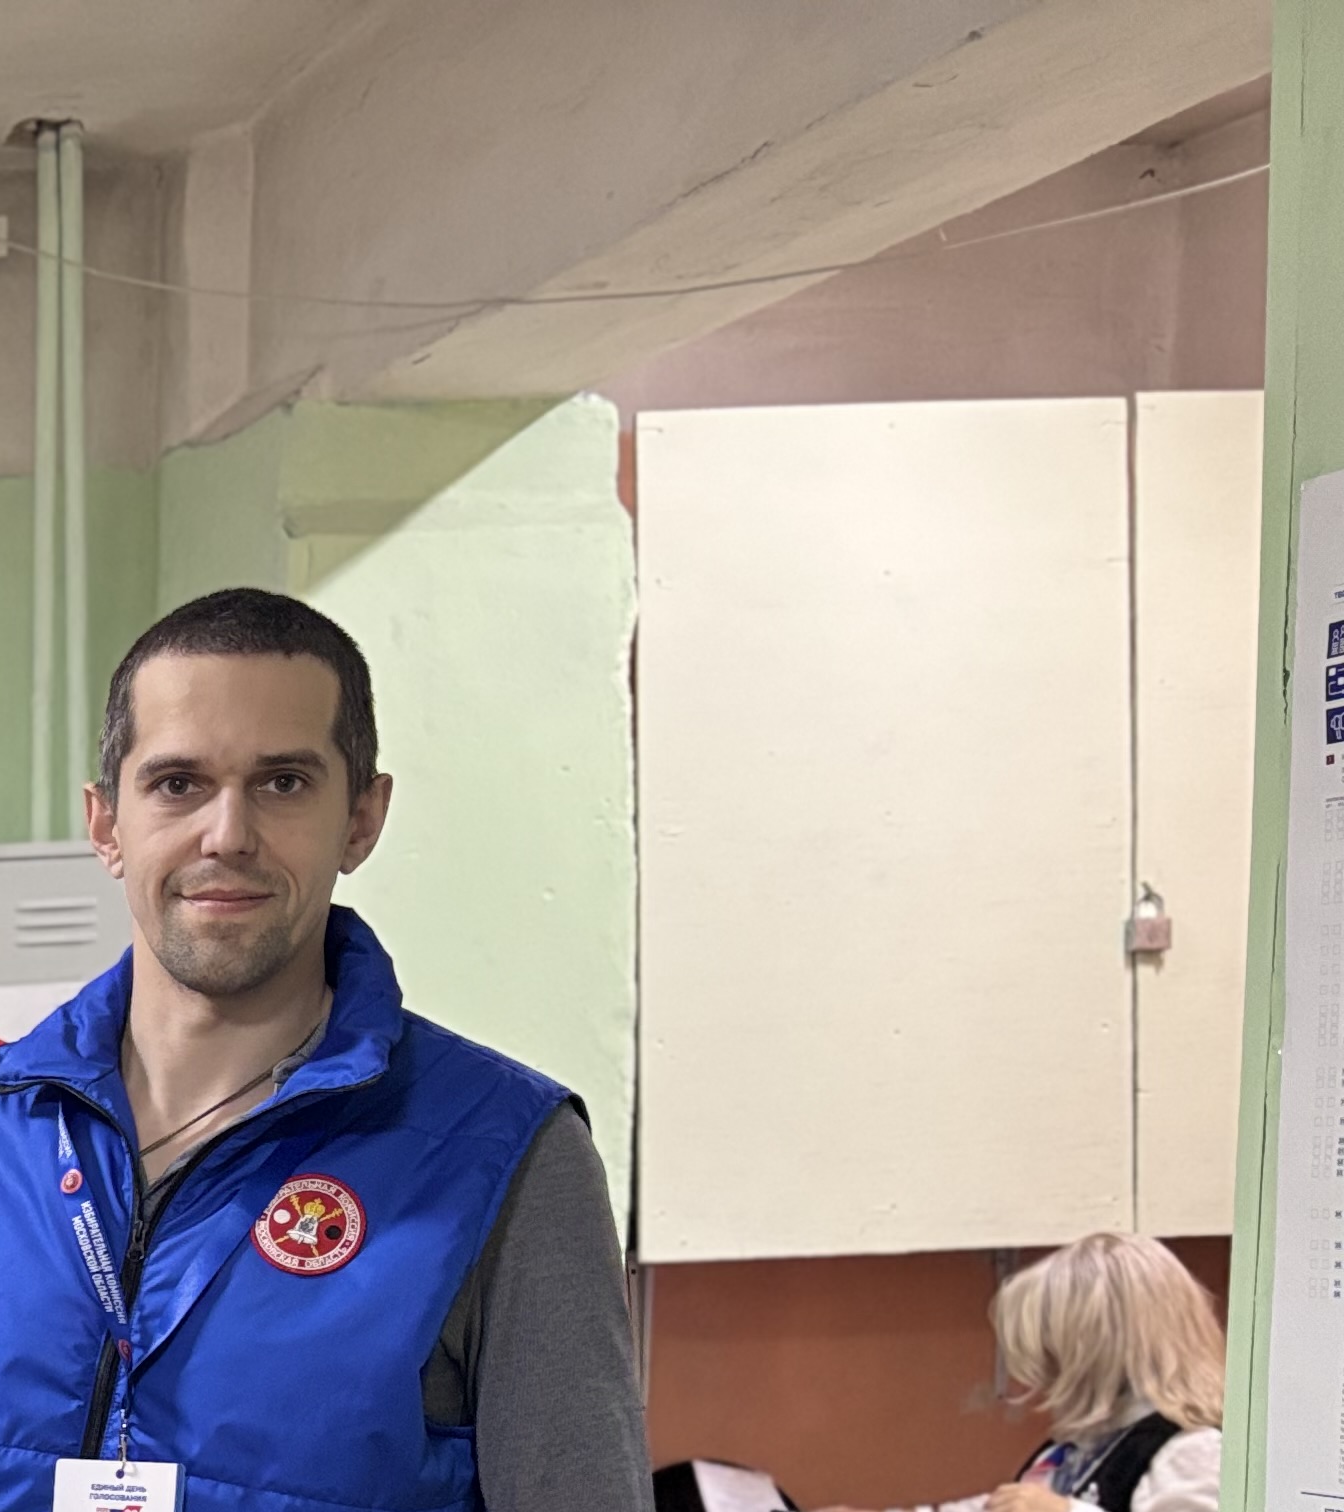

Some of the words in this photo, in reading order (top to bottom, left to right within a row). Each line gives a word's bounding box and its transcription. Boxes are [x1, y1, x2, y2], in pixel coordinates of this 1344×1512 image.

[72, 1216, 97, 1273] МОСКОВСКОЙ
[90, 1270, 114, 1313] ОБЛАСТИ
[80, 1201, 113, 1276] ИЗБИРАТЕЛЬНАЯ
[105, 1272, 128, 1325] КОМИССИЯ
